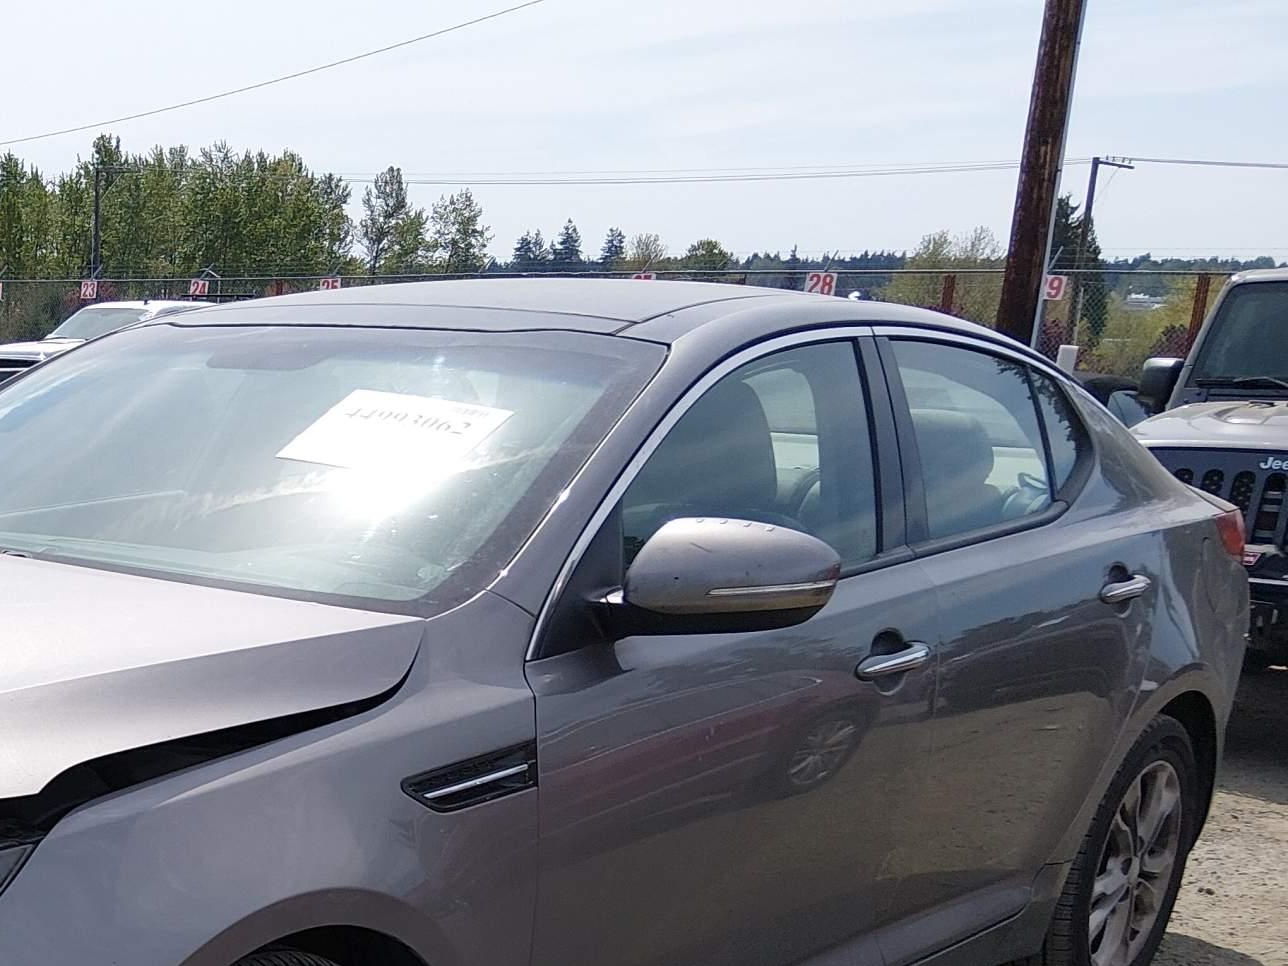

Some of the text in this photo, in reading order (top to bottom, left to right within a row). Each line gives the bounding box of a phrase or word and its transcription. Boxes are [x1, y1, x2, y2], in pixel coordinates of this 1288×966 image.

[82, 282, 97, 298] 23
[191, 280, 206, 295] 24
[808, 273, 834, 295] 28
[1046, 276, 1064, 299] 9
[1258, 456, 1288, 471] Jee
